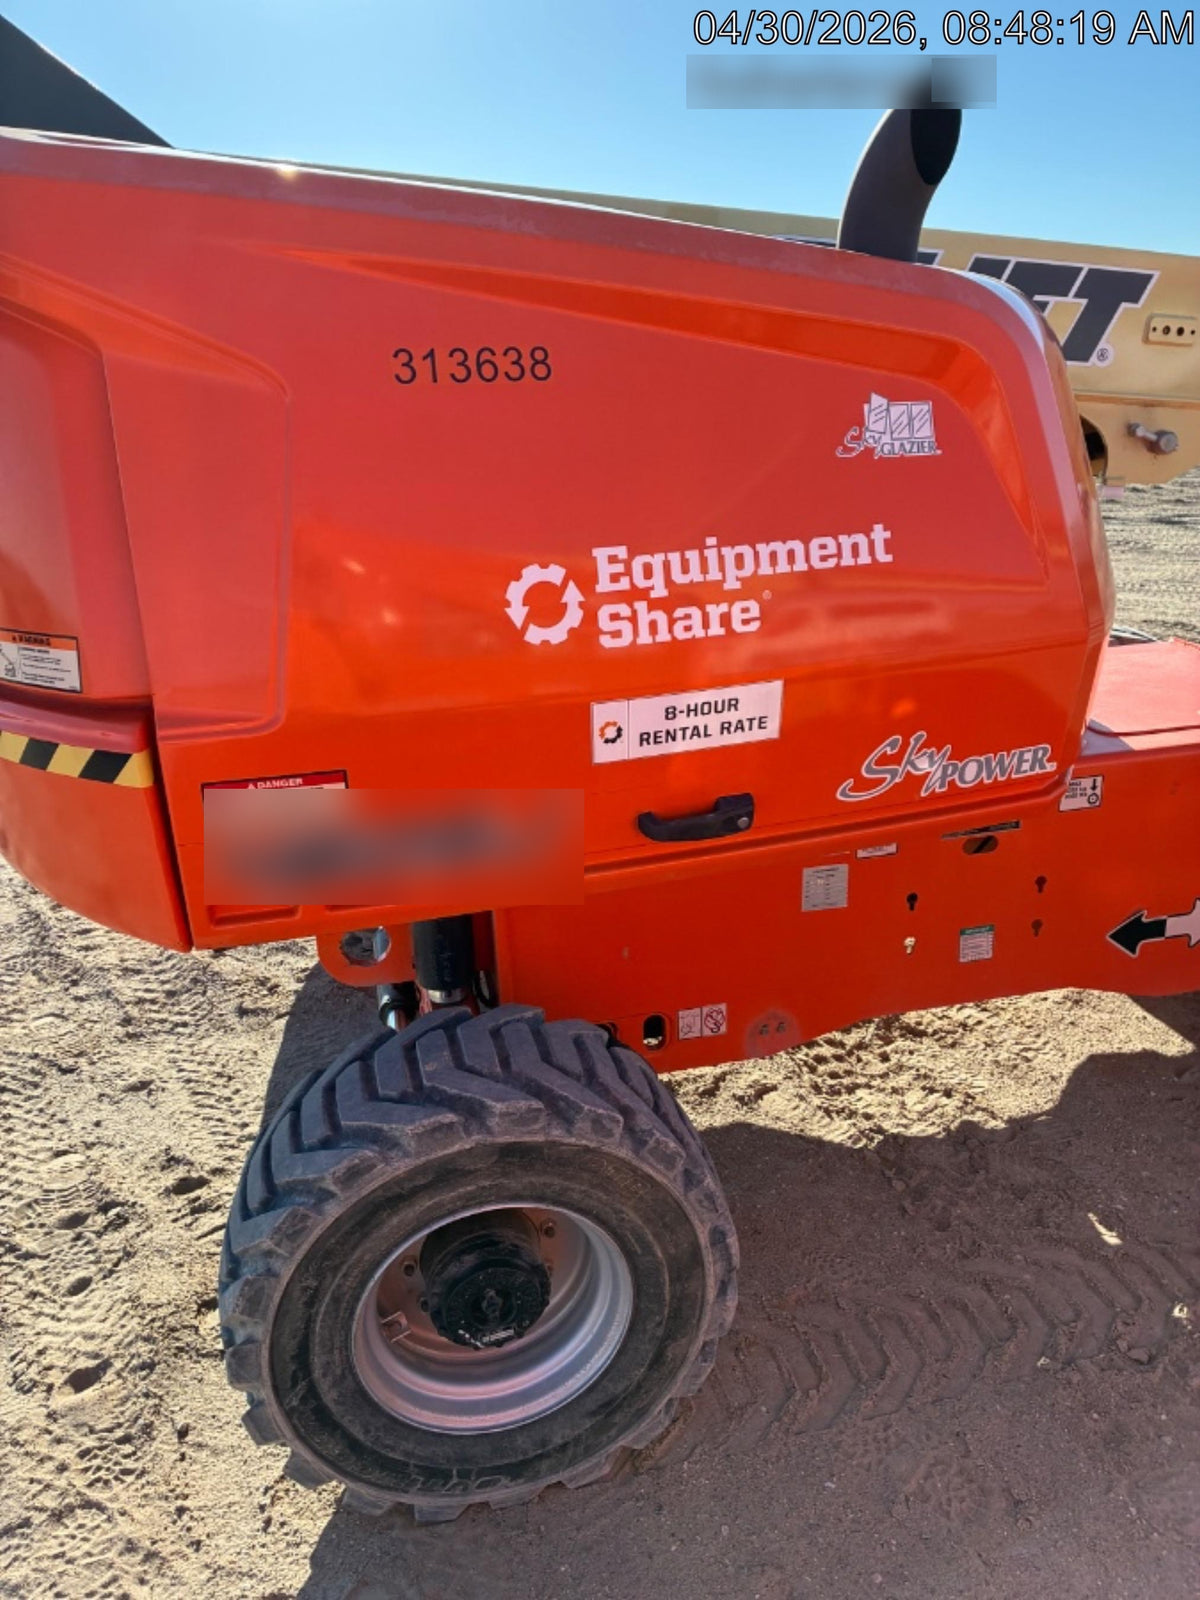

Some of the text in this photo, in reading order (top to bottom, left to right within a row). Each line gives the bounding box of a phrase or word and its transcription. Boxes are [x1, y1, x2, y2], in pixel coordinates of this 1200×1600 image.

[393, 346, 553, 384] 313638
[592, 524, 893, 599] Equipment
[596, 597, 762, 649] Share
[664, 697, 740, 721] 8-HOUR
[638, 715, 769, 748] RENTAL RATE
[256, 777, 304, 789] DANGER
